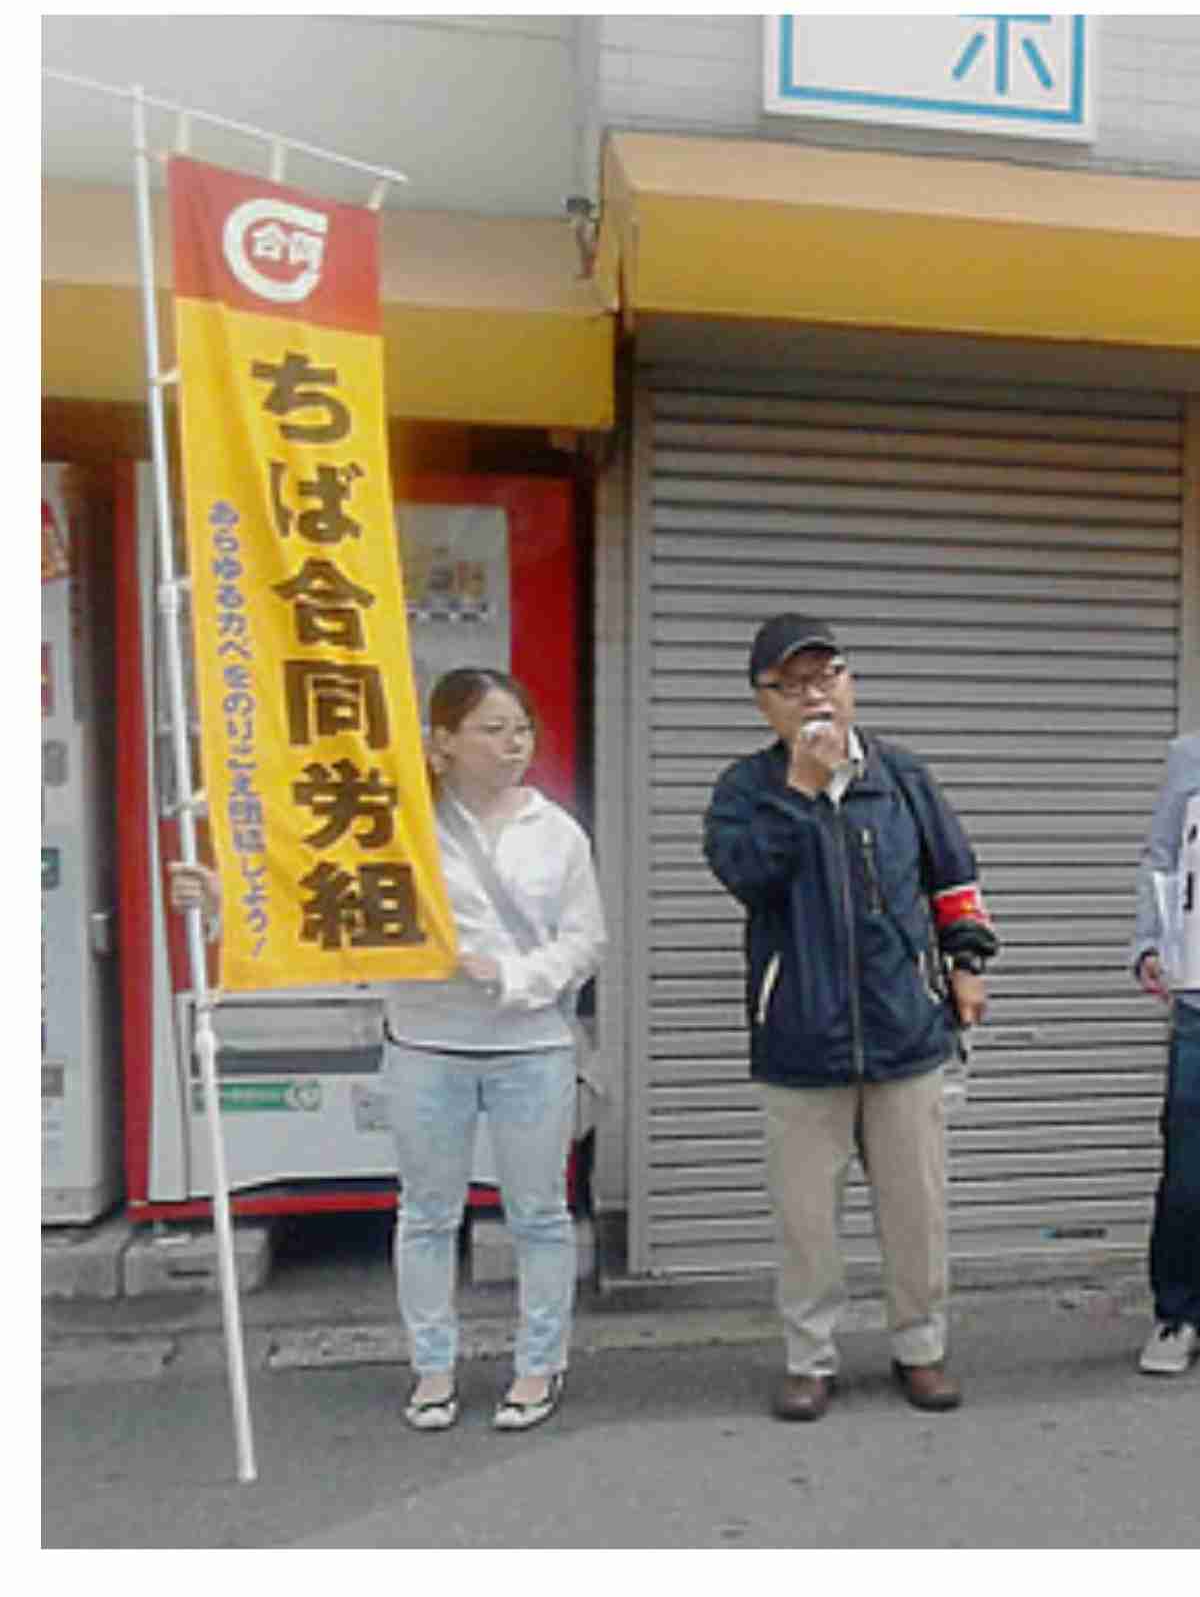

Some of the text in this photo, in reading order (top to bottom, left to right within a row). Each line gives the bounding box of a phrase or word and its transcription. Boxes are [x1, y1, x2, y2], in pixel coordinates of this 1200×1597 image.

[250, 350, 427, 952] ちば合同労組
